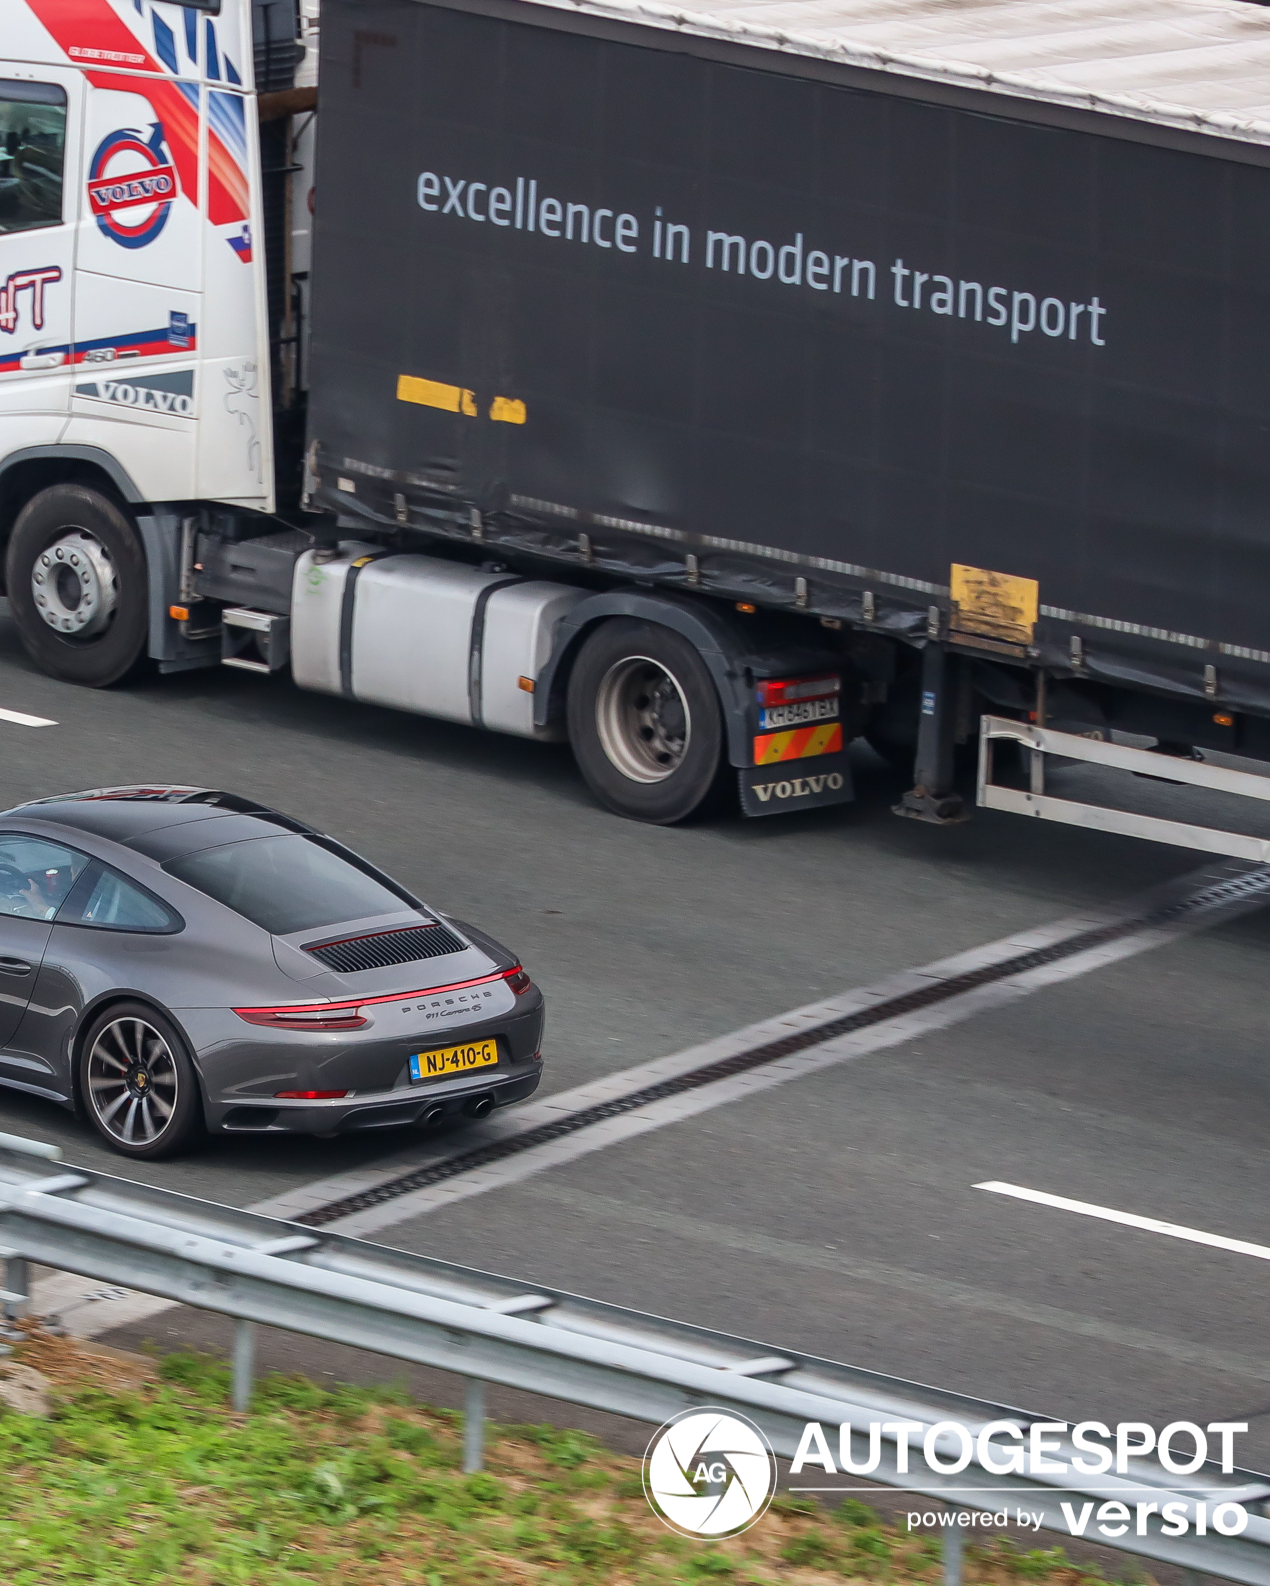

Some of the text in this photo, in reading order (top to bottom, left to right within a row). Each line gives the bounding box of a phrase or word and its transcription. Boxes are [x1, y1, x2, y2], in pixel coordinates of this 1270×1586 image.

[91, 175, 172, 206] VOLVO
[416, 171, 1107, 347] excellence in modern transport
[95, 380, 193, 415] VOLVO
[751, 772, 844, 802] VOLVO
[401, 991, 492, 1013] PORSCHE
[425, 1012, 439, 1020] 911
[440, 1007, 471, 1017] Carrera
[412, 1068, 420, 1076] NL
[426, 1044, 491, 1073] NJ-410-G
